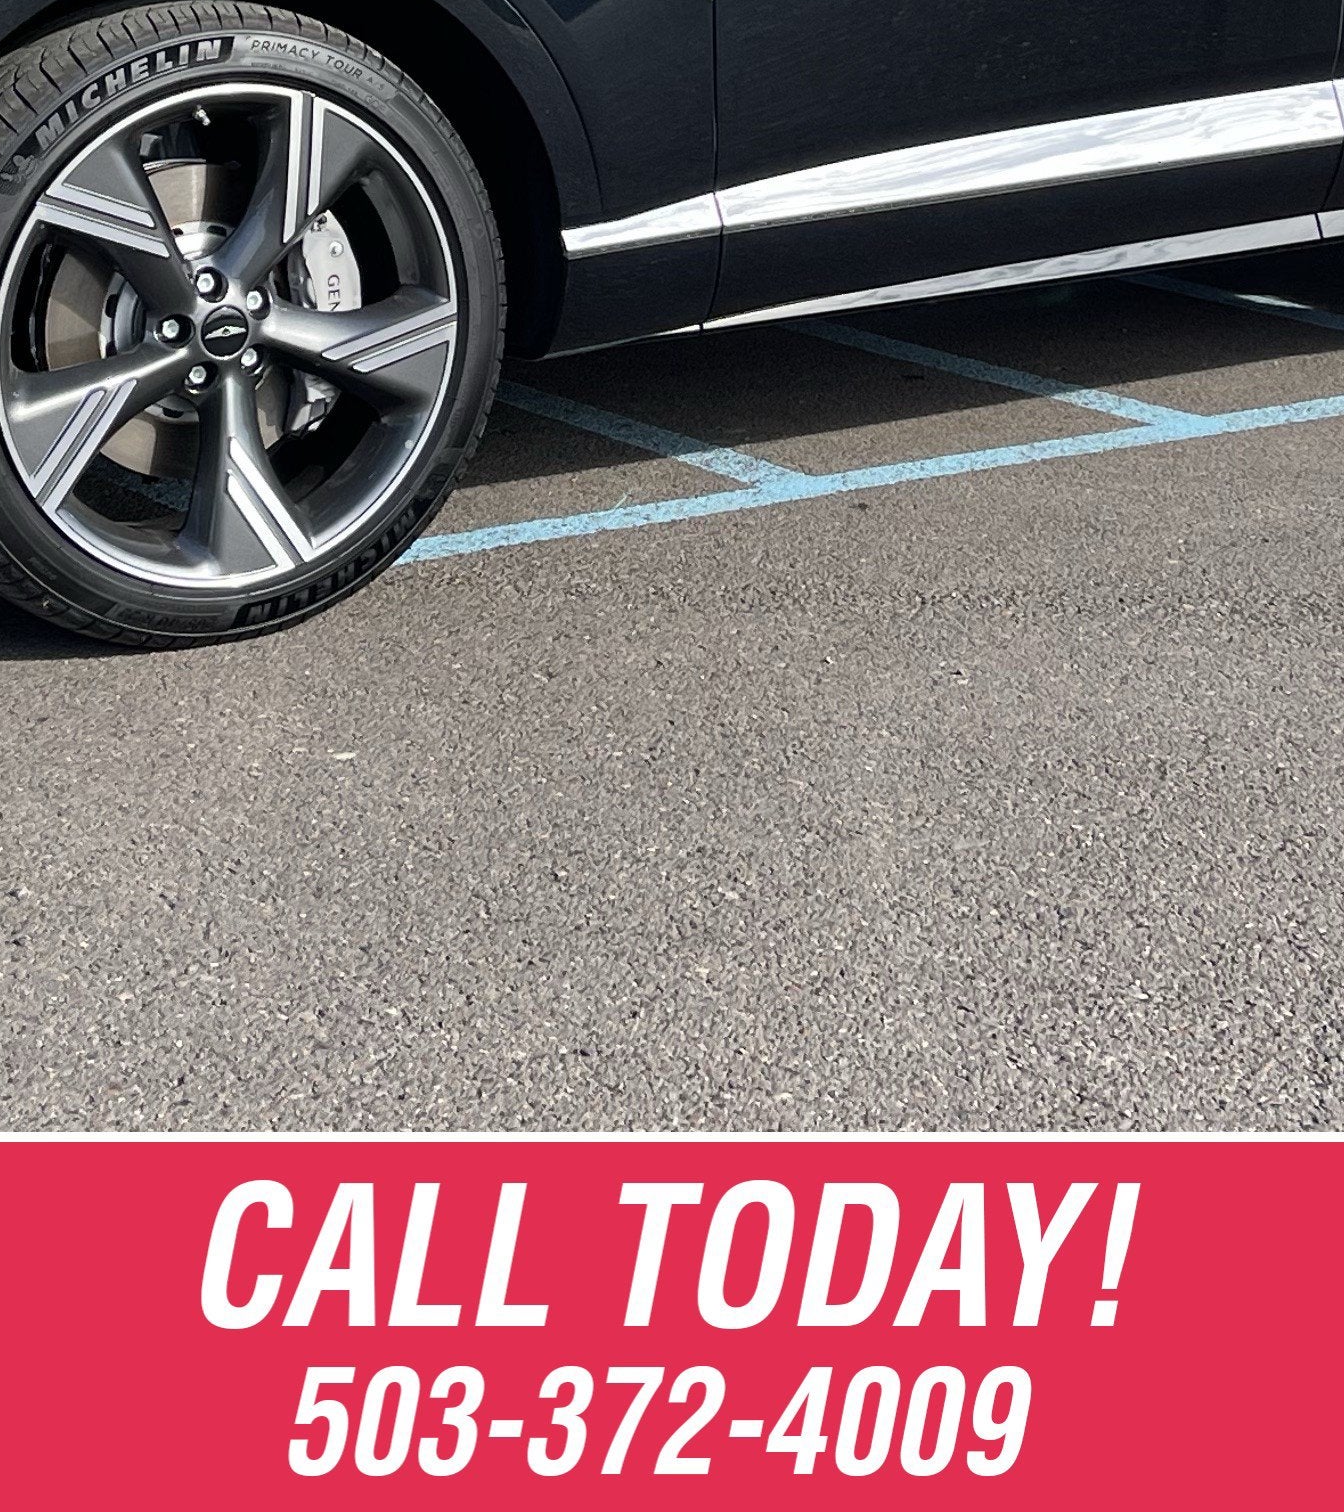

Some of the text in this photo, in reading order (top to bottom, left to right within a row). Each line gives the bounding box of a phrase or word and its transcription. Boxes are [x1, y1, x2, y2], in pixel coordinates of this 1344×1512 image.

[35, 39, 222, 150] MICHELIN
[251, 39, 321, 61] PRIMACY
[326, 53, 363, 79] TOUR
